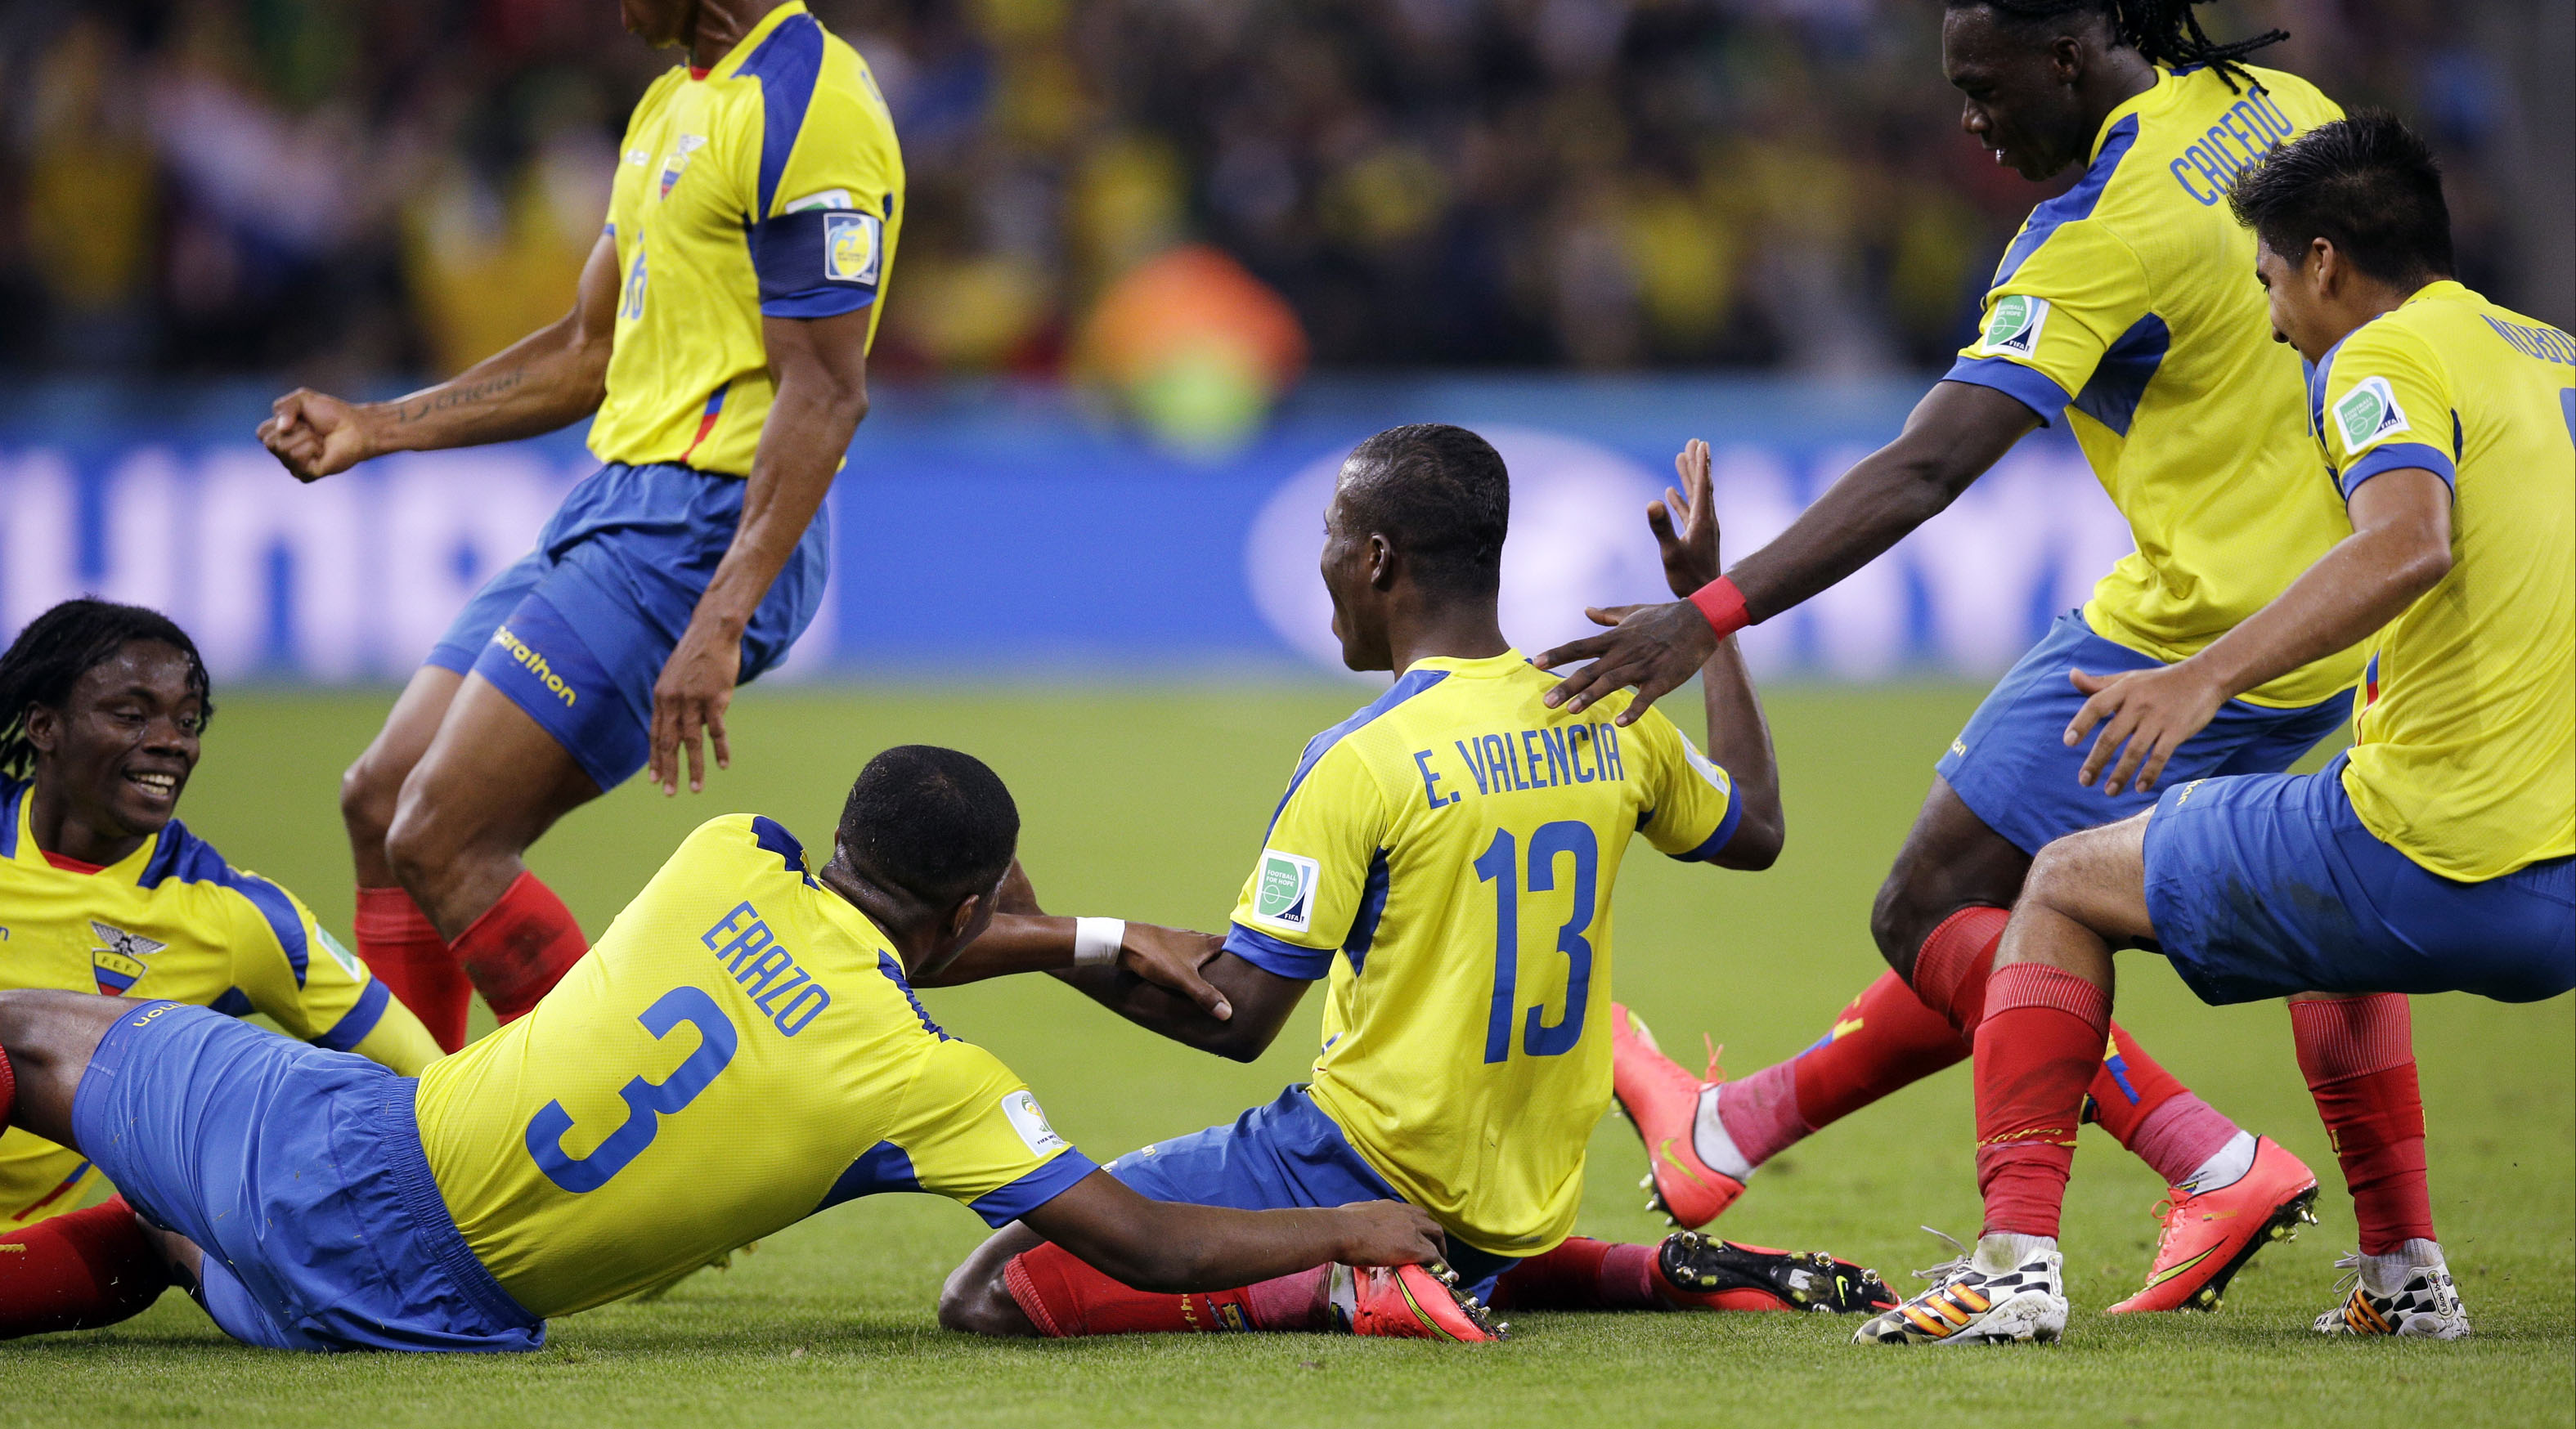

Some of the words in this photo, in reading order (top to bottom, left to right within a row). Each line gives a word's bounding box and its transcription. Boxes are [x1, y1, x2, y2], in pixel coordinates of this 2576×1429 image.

[2170, 84, 2294, 206] CAICEDO
[2008, 340, 2026, 350] FIFA
[1413, 749, 1461, 809] E.
[1455, 723, 1625, 795] VALENCIA
[1266, 876, 1277, 884] FOR
[1277, 879, 1294, 888] HOPE
[1267, 870, 1296, 881] FOOTBALL
[1284, 913, 1299, 921] FIFA
[701, 900, 831, 1037] ERAZO
[1473, 820, 1598, 1064] 13
[526, 986, 738, 1194] 3
